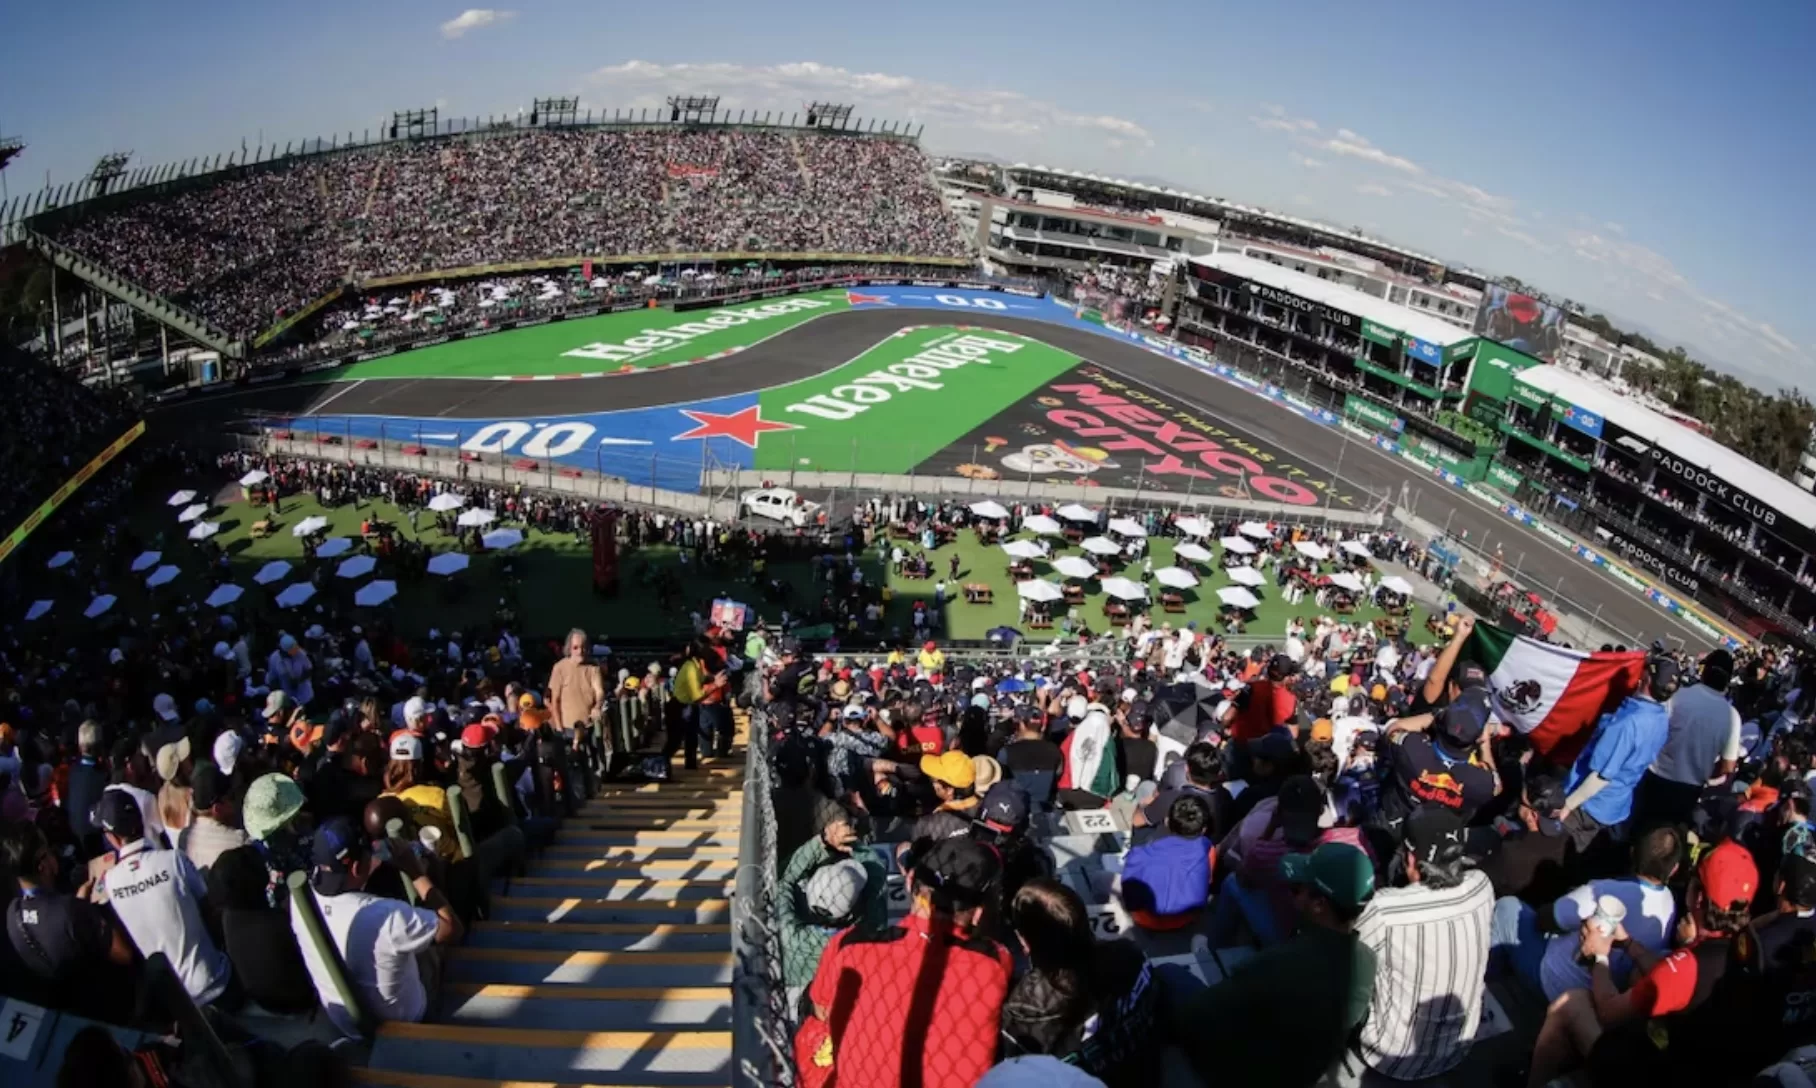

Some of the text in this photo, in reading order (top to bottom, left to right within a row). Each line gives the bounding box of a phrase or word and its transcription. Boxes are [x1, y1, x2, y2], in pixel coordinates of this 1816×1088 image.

[560, 298, 832, 362] Heineken
[1261, 287, 1314, 312] PADDOCK
[784, 334, 1026, 420] Heineken
[1046, 409, 1218, 480] CITY
[1050, 383, 1319, 506] MEXICO
[1093, 374, 1128, 390] THE
[1125, 389, 1174, 411] CITY
[1172, 411, 1231, 438] THAT
[1225, 437, 1276, 462] HAS
[1651, 450, 1729, 499] PADDOCK
[1732, 493, 1777, 527] CLUB
[1613, 535, 1666, 570] PADDOCK
[1667, 567, 1699, 591] CLUB
[1409, 779, 1464, 809] Red Bull
[112, 870, 170, 899] PETRONAS
